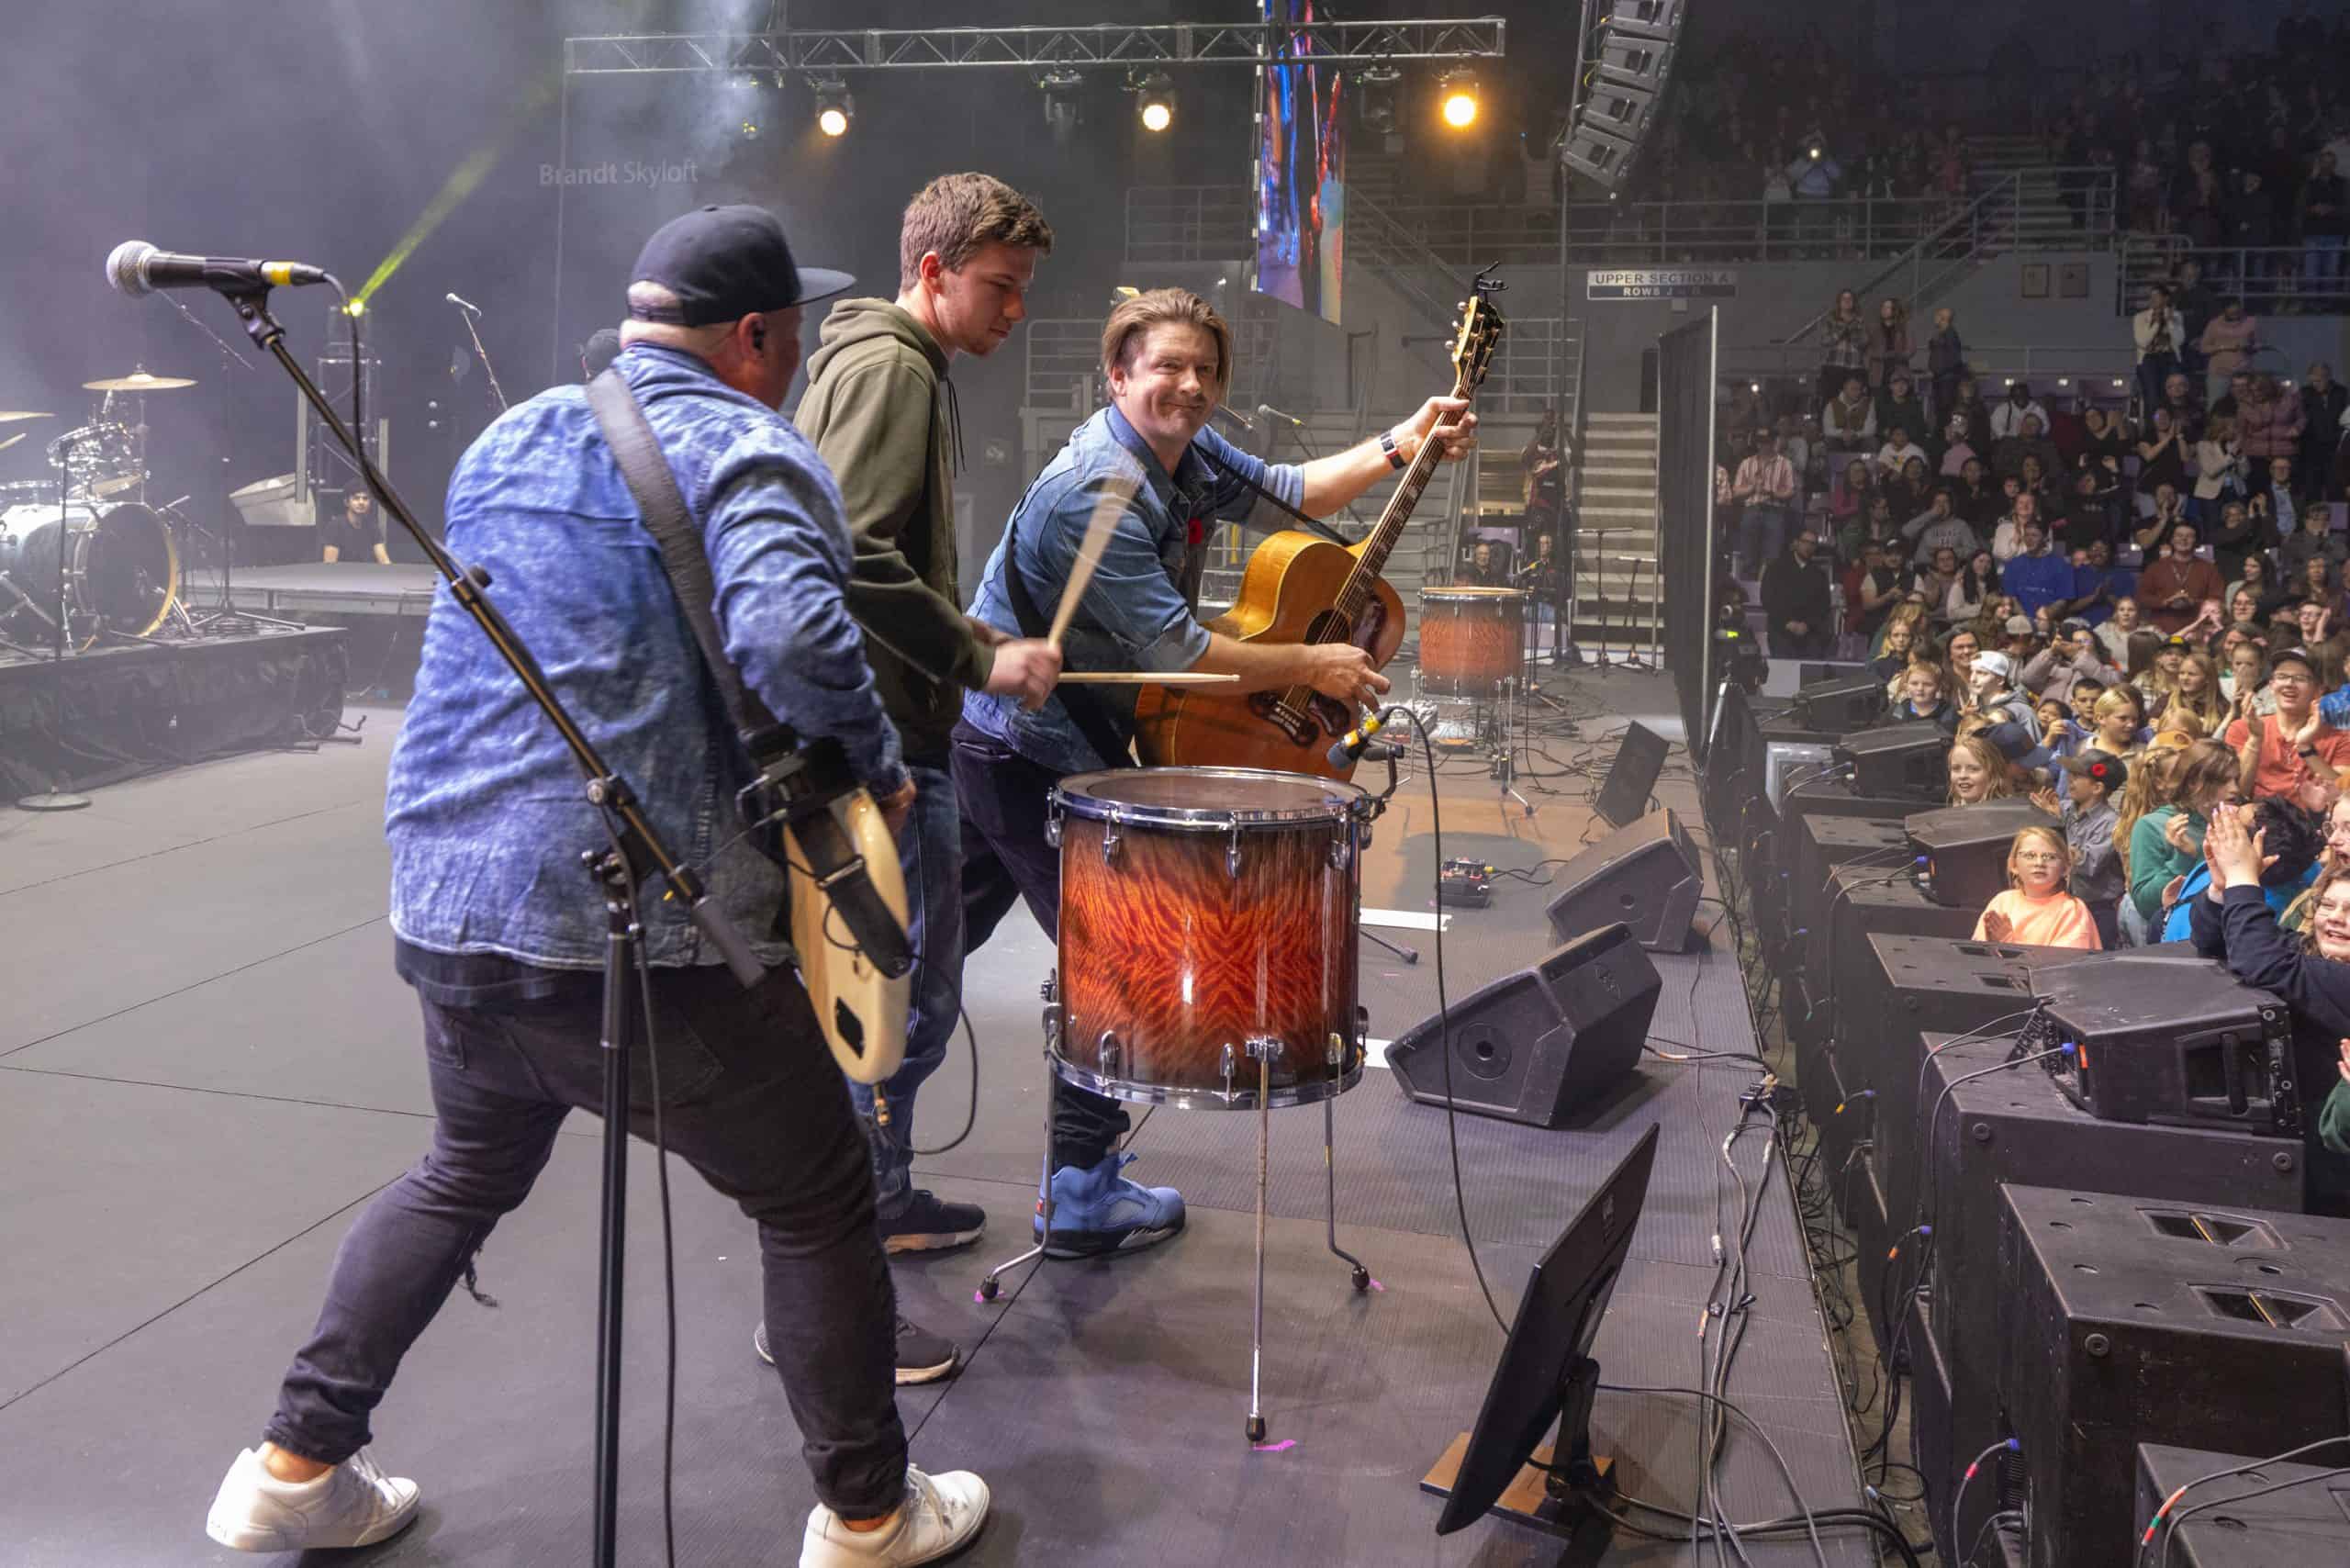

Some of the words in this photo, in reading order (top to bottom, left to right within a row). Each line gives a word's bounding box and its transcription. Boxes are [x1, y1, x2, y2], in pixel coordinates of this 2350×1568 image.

[539, 162, 618, 184] Brandt
[623, 158, 699, 190] Skyloft
[1595, 273, 1643, 284] UPPER
[1650, 273, 1713, 284] SECTION
